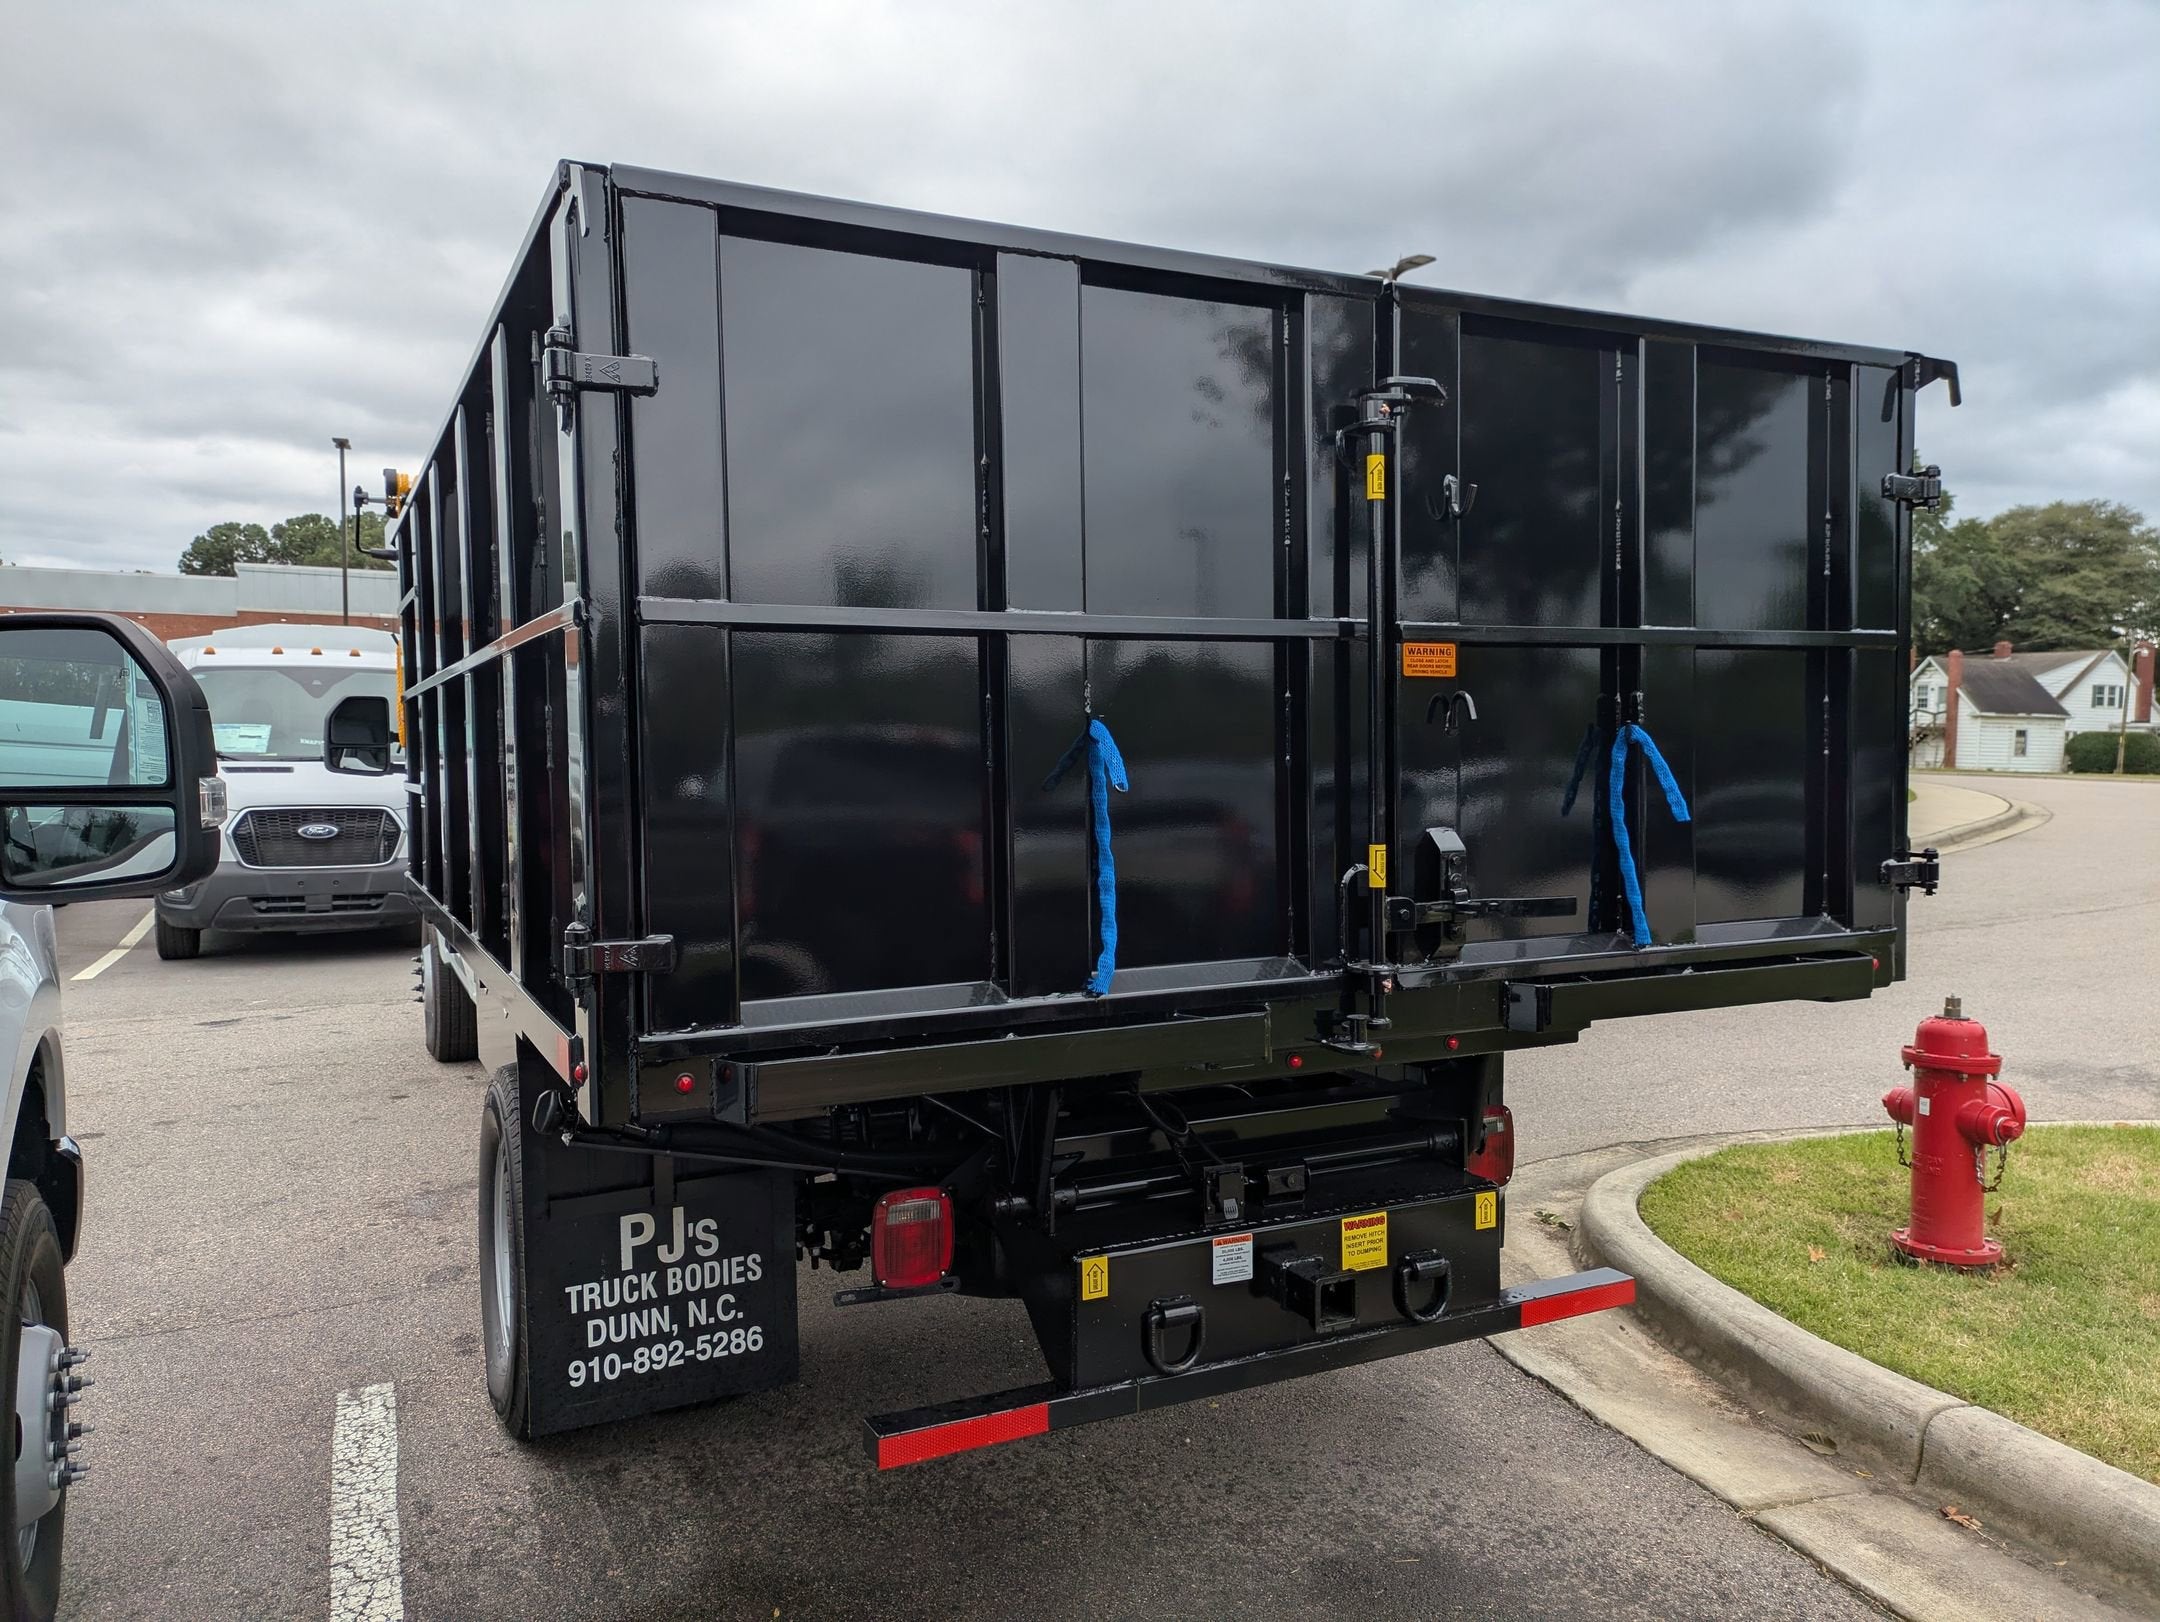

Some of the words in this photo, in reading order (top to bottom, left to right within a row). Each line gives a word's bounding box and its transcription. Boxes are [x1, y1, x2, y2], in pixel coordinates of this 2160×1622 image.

[1407, 647, 1452, 656] WARNING
[1344, 1216, 1385, 1231] WARNING
[1344, 1233, 1368, 1241] REMOVE
[1369, 1230, 1385, 1238] HITCH
[1346, 1241, 1365, 1250] INSERT
[1367, 1238, 1384, 1246] PRIOR
[1356, 1246, 1382, 1256] DUMPING
[565, 1271, 658, 1314] TRUCK
[667, 1254, 763, 1296] BODIES
[587, 1305, 678, 1348] DUNN,
[688, 1294, 744, 1328] N.C.
[568, 1326, 764, 1388] 910-892-5286
